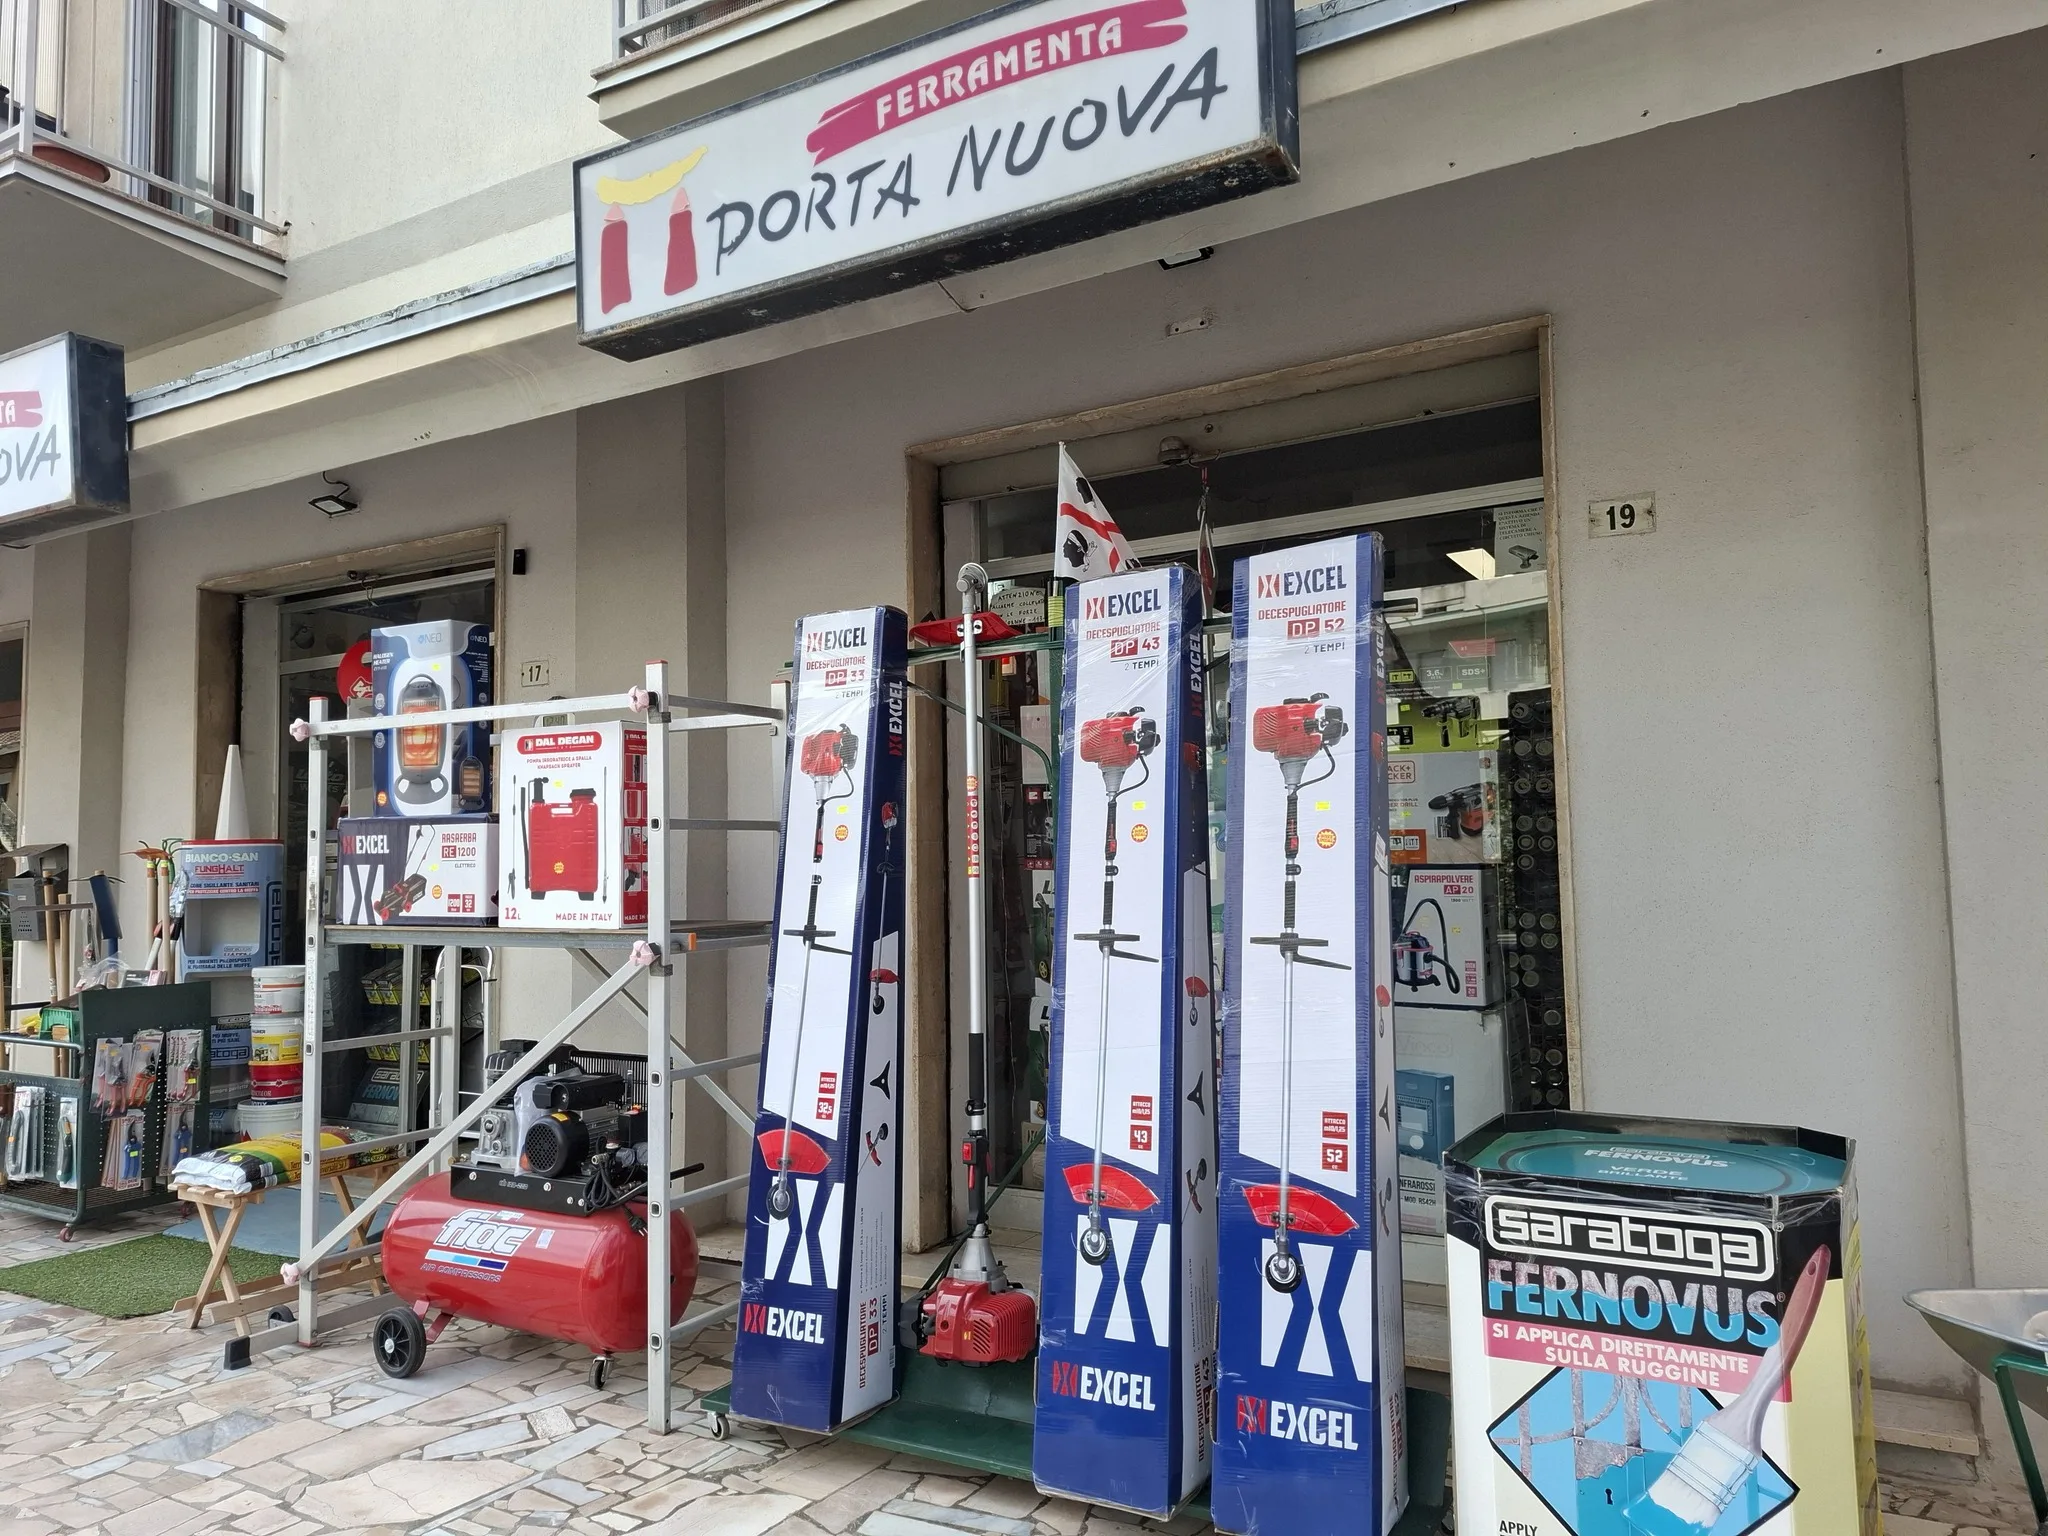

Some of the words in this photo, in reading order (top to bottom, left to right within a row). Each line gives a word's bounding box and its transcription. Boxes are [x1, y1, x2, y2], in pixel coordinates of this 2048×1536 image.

[875, 16, 1123, 131] FERRAMENTA
[707, 152, 921, 277] PORTA
[946, 46, 1229, 198] NUOVA
[1606, 503, 1636, 531] 19
[1284, 565, 1347, 596] EXCEL
[1108, 588, 1161, 617] EXCEL
[1258, 600, 1347, 620] DECESPUGLIATORE
[1086, 621, 1161, 640] DECESPUGLIATORE
[1291, 621, 1316, 638] DP
[1324, 618, 1346, 633] 52
[824, 626, 867, 651] EXCEL
[1114, 640, 1135, 656] DP
[1141, 636, 1161, 651] 43
[1313, 642, 1345, 653] TEMPI
[806, 655, 866, 670] DECESPUGLIATORE
[1132, 659, 1160, 670] TEMPI
[1190, 633, 1203, 693] EXCEL
[1462, 668, 1485, 676] SDS+
[528, 664, 541, 682] 17
[828, 671, 846, 686] DP
[850, 669, 865, 683] 33
[889, 681, 903, 735] EXCEL
[535, 738, 555, 747] DAL
[557, 735, 595, 745] DEGAN
[356, 834, 390, 855] EXCEL
[441, 832, 477, 844] RASAERBA
[443, 846, 456, 858] RE
[458, 845, 476, 857] 1200
[1414, 874, 1474, 884] ASPIRAPOLVERE
[1445, 885, 1460, 894] AP
[1461, 886, 1474, 894] 20
[504, 907, 517, 920] 12
[555, 913, 577, 921] MADE
[579, 913, 589, 921] IN
[591, 913, 613, 921] ITALY
[1133, 1130, 1148, 1143] 43
[1326, 1149, 1343, 1164] 52
[1584, 1149, 1730, 1168] FERNOVUS
[1598, 1169, 1688, 1182] BRILLANTE
[1609, 1165, 1683, 1177] VERDE
[1498, 1208, 1760, 1279] saratoga
[420, 1262, 436, 1272] AIR
[438, 1265, 502, 1282] COMPRESSORS
[869, 1297, 878, 1318] 33
[1487, 1258, 1782, 1349] FERNOVUS
[767, 1307, 825, 1345] EXCEL
[860, 1300, 868, 1389] DECESPUGLIATORE
[868, 1327, 878, 1351] DP
[1492, 1322, 1509, 1340] SI
[1515, 1327, 1594, 1351] APPLICA
[1600, 1336, 1749, 1375] DIRETTAMENTE
[1202, 1357, 1210, 1381] 43
[1544, 1346, 1609, 1371] SULLA
[1617, 1354, 1721, 1388] RUGGINE
[1080, 1365, 1156, 1412] EXCEL
[1270, 1400, 1359, 1451] EXCEL
[1499, 1519, 1538, 1536] APPLY
